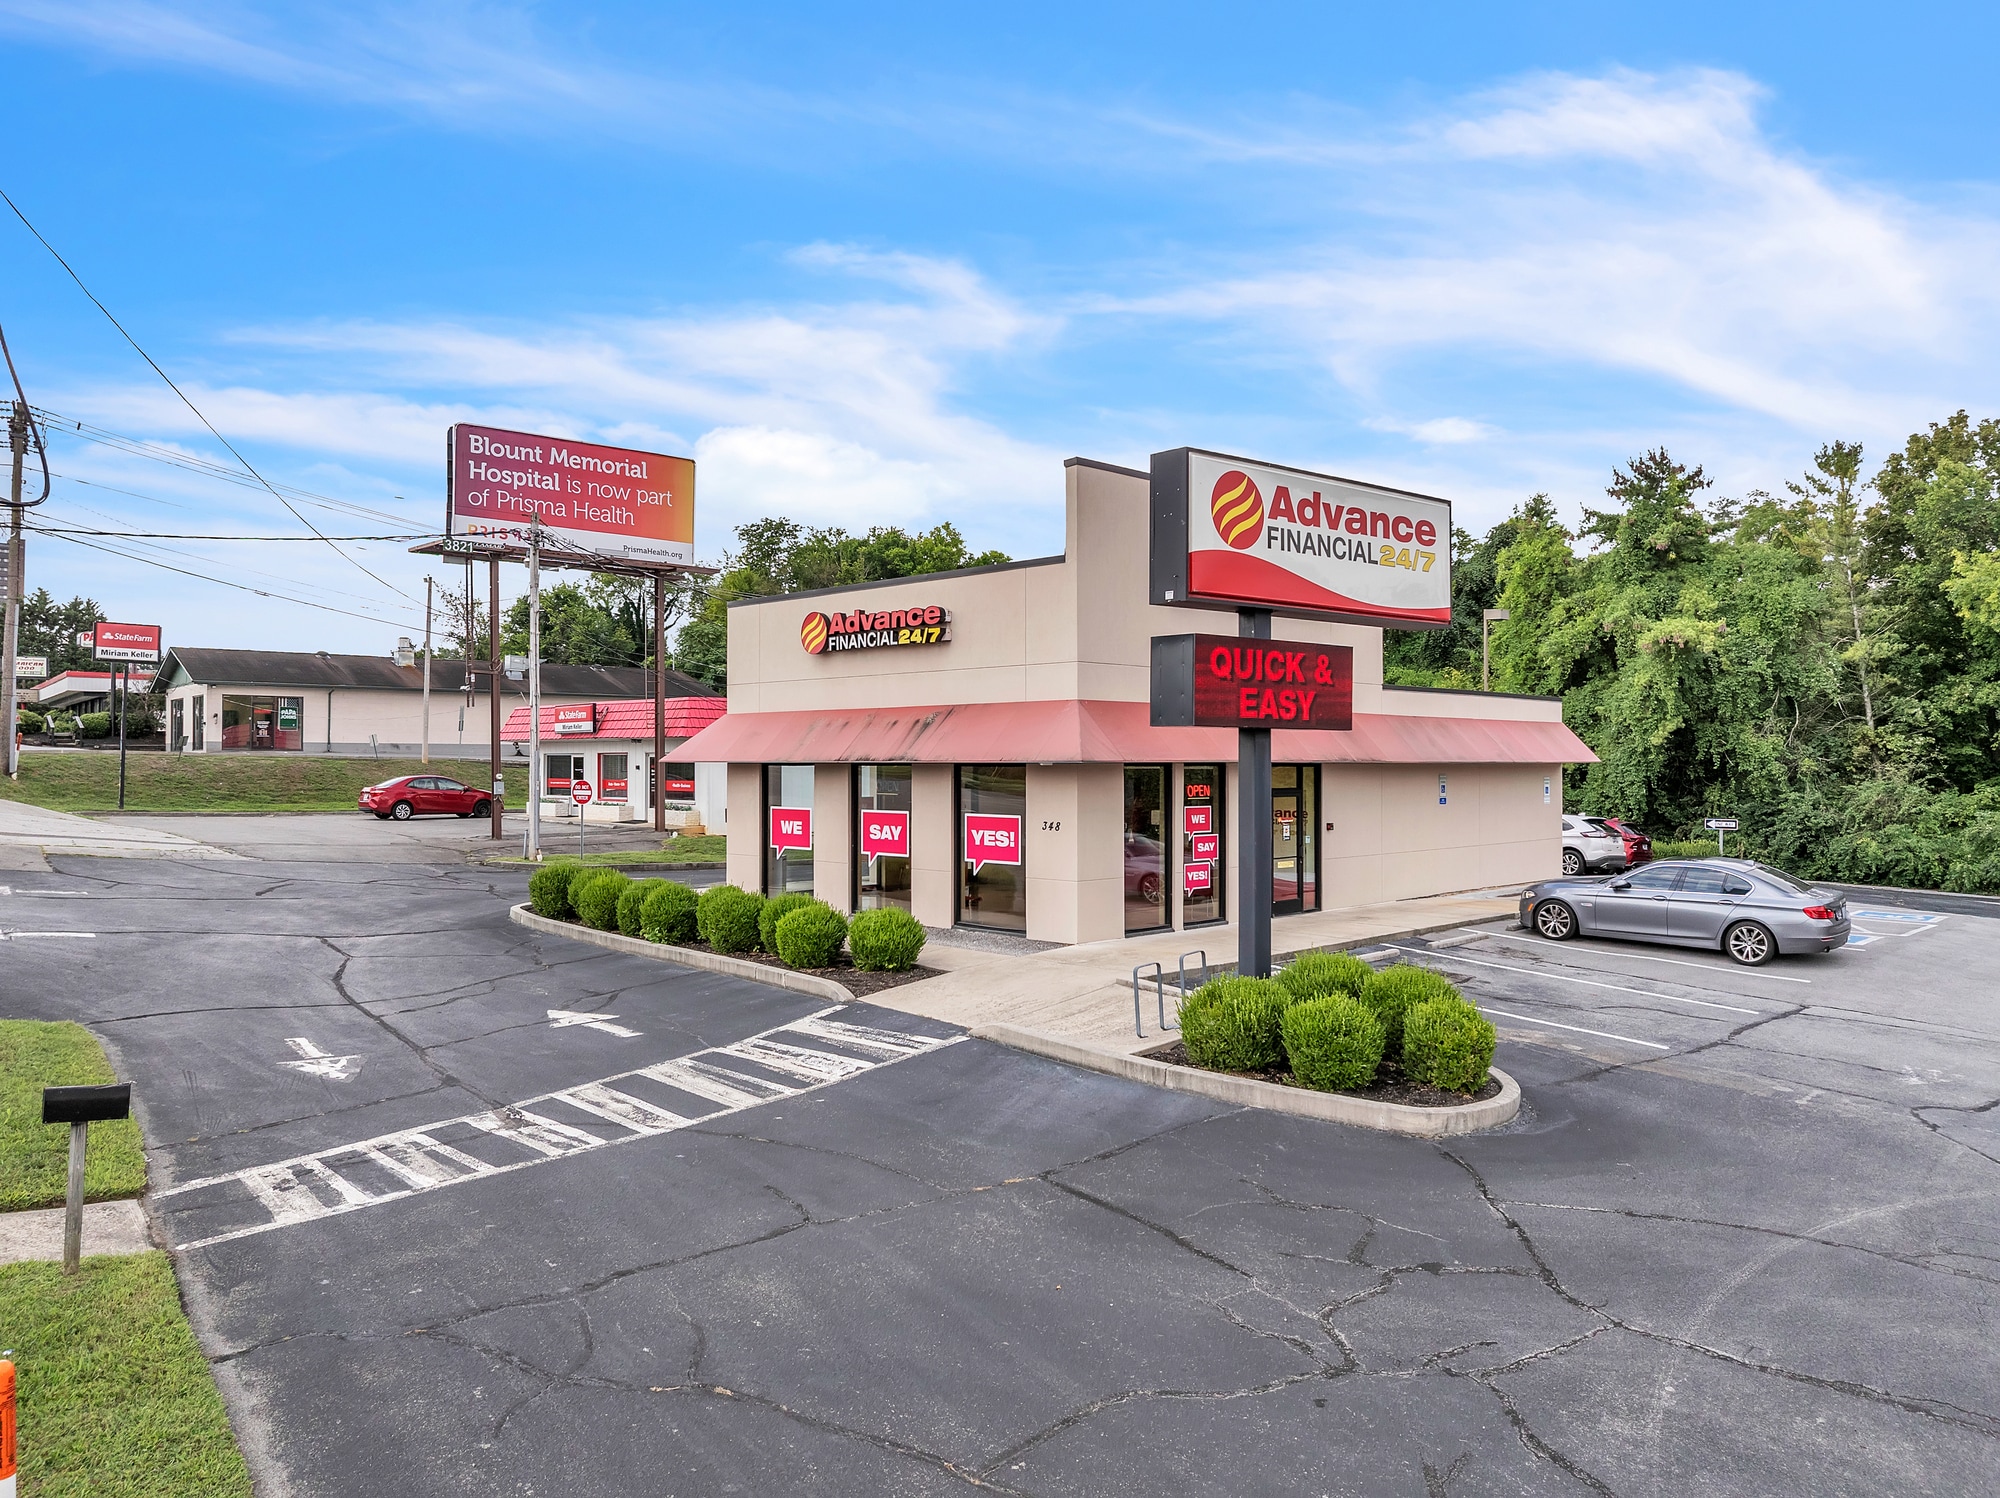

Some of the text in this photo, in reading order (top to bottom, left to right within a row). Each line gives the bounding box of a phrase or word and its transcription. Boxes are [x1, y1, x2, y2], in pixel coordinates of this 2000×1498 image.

[469, 434, 648, 480] Blount Memorial
[469, 460, 673, 508] Hospital is now part
[468, 488, 635, 526] of Prisma Health
[1267, 485, 1437, 546] Advance
[444, 539, 474, 553] 3821
[623, 544, 683, 560] PrismaHealth.org
[1267, 525, 1436, 573] FINANCIAL 24/7
[829, 605, 942, 635] Advance
[828, 627, 941, 652] FINANCIAL 24/7
[101, 649, 153, 659] Miriam Keller
[1209, 647, 1334, 686] QUICK &
[1239, 687, 1316, 721] EASY
[1187, 784, 1211, 797] OPEN
[780, 820, 803, 835] WE
[1041, 820, 1061, 832] 348
[1191, 814, 1206, 824] WE
[869, 824, 902, 841] SAY
[971, 829, 1015, 848] YES!
[1197, 842, 1215, 852] SAY
[1187, 870, 1208, 881] YES!
